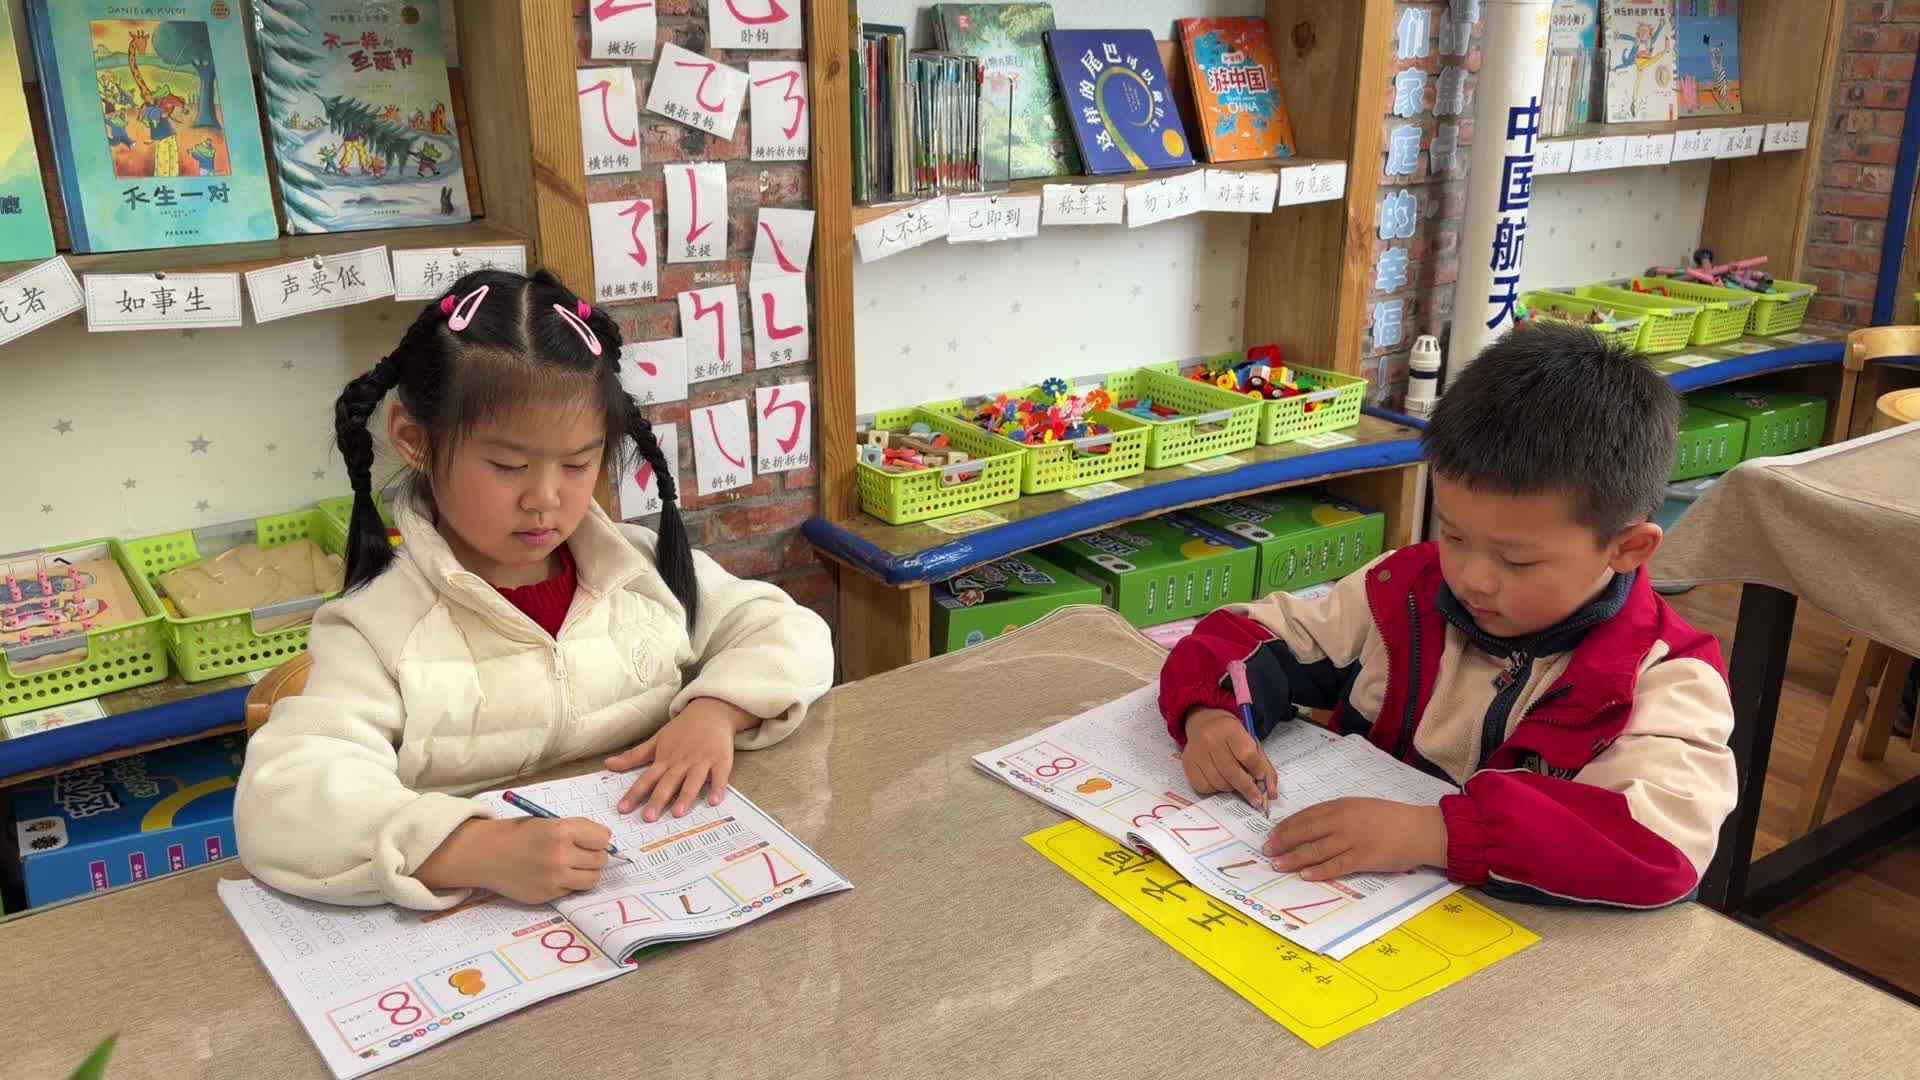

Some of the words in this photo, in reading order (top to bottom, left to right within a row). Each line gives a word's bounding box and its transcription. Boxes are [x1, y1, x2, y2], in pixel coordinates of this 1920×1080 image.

[740, 29, 769, 44] 卧钩
[348, 47, 413, 73] 圣诞节
[1208, 66, 1267, 93] 游中国
[664, 99, 715, 131] 横折弯钩
[588, 153, 630, 170] 横斜钩
[1487, 96, 1541, 330] 中国航天
[876, 213, 934, 248] 人不在
[685, 243, 712, 257] 竖提
[280, 264, 366, 304] 声要低
[116, 286, 212, 316] 如事生
[1035, 756, 1077, 777] 8
[761, 852, 805, 888] 7
[616, 899, 652, 925] 7
[1280, 896, 1344, 925] 7
[540, 929, 591, 964] 8
[378, 991, 423, 1026] 8
